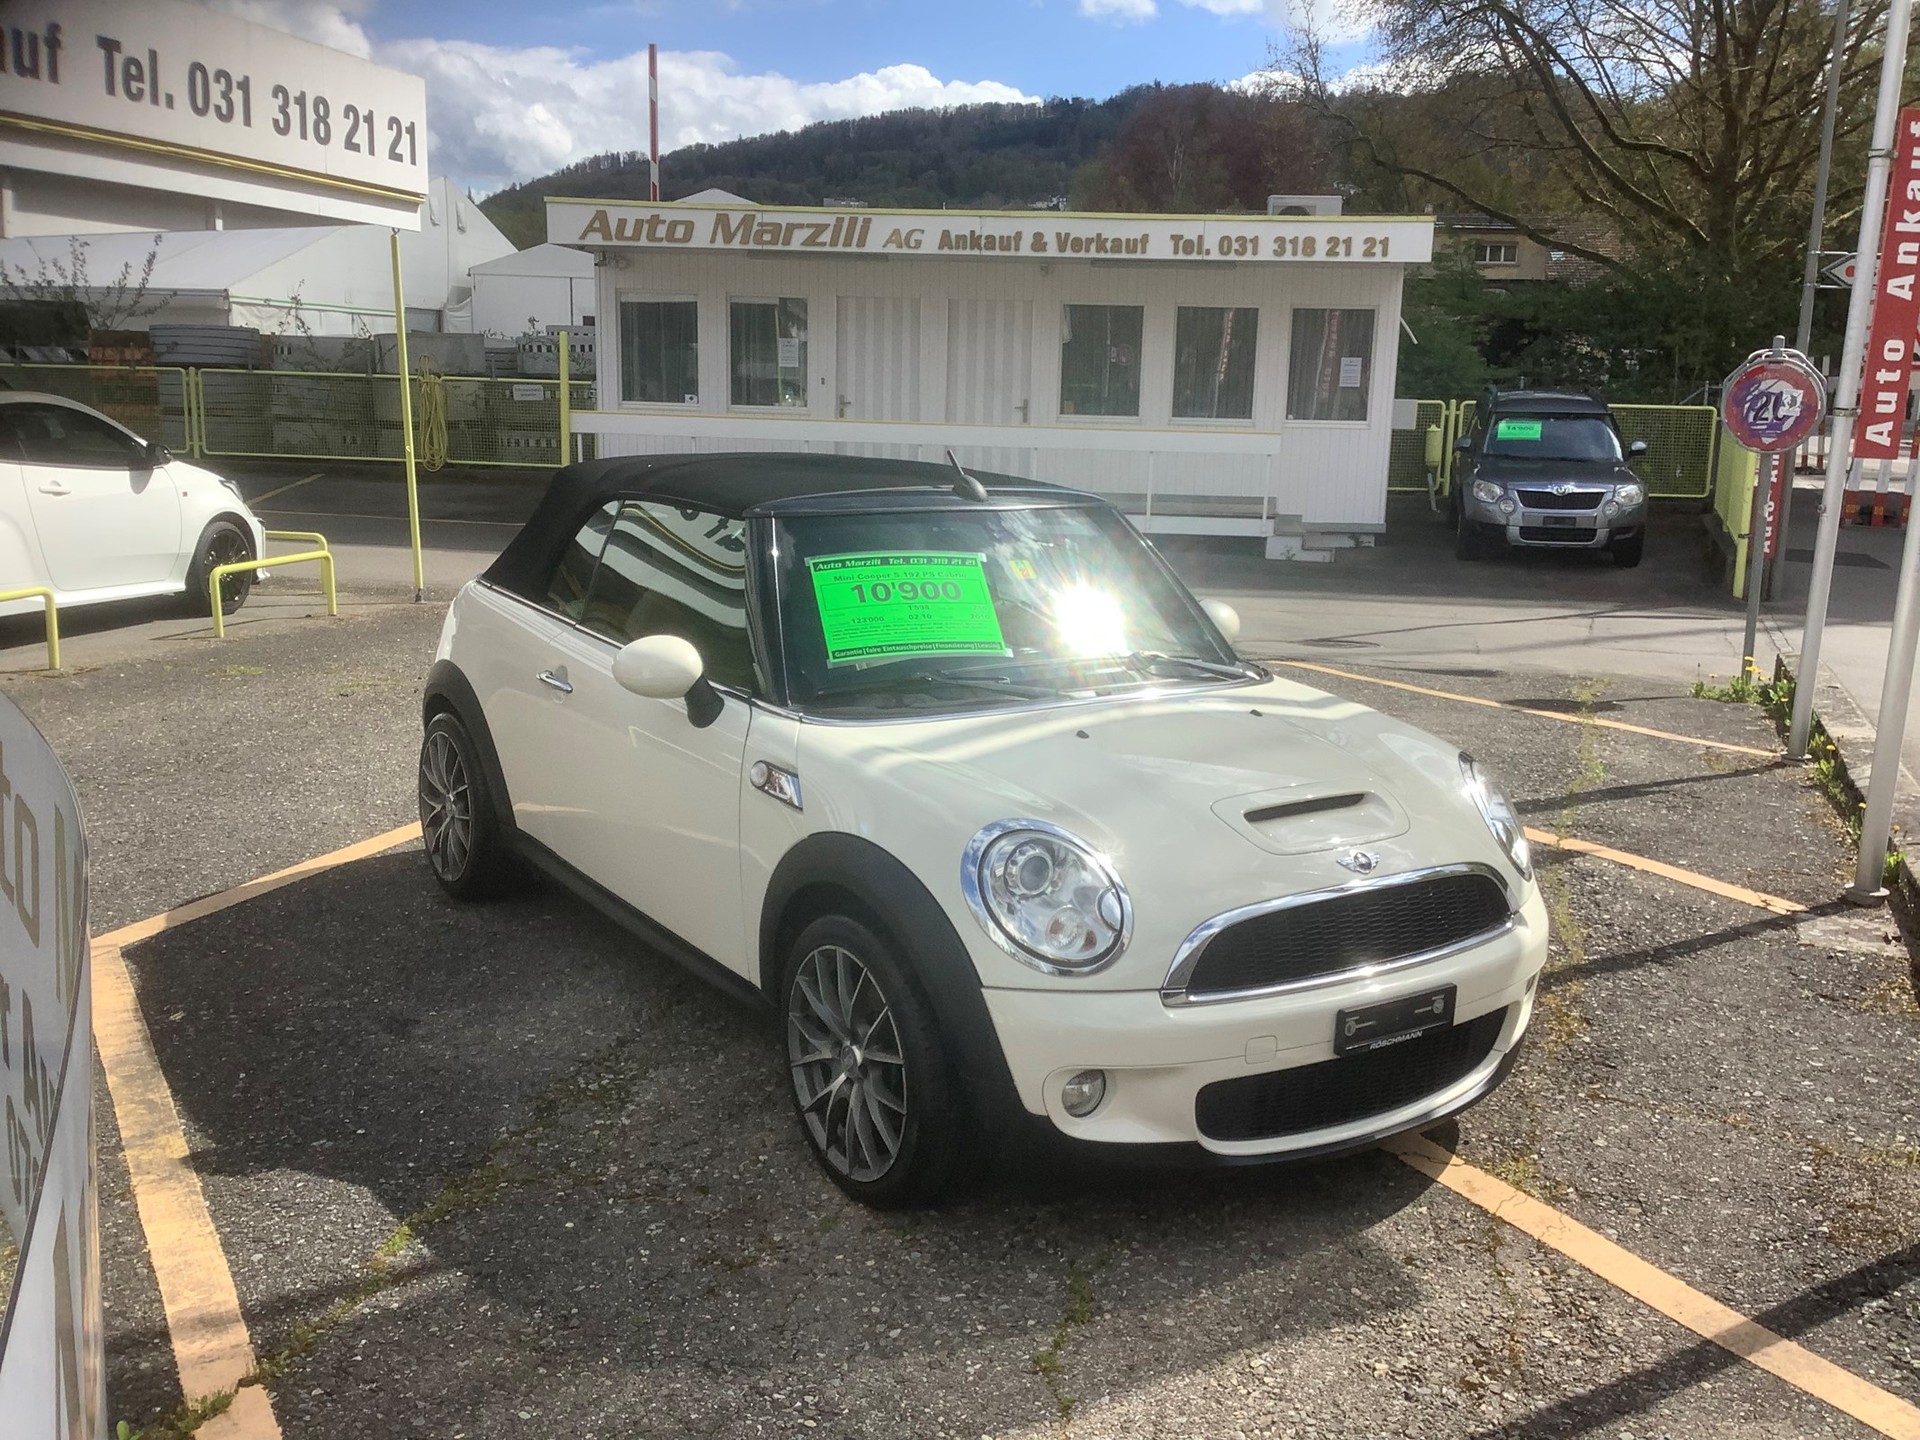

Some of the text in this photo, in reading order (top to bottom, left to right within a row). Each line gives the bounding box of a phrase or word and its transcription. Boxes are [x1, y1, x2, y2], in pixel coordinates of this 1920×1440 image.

[96, 34, 175, 110] Tel.
[187, 61, 252, 128] 031
[272, 84, 332, 146] 318
[343, 103, 376, 157] 21
[387, 116, 417, 167] 21
[578, 209, 1390, 258] Auto Marzili AG Ankauf & Verkauf Tel. 031 318 21 21
[1865, 338, 1906, 448] Auto
[816, 562, 842, 571] Auto
[845, 559, 881, 567] Marzili
[910, 557, 928, 566] 031
[931, 558, 948, 566] 318
[951, 558, 962, 566] 21
[833, 574, 855, 582] Mini
[857, 572, 891, 581] Cooper
[851, 580, 962, 604] 10'900
